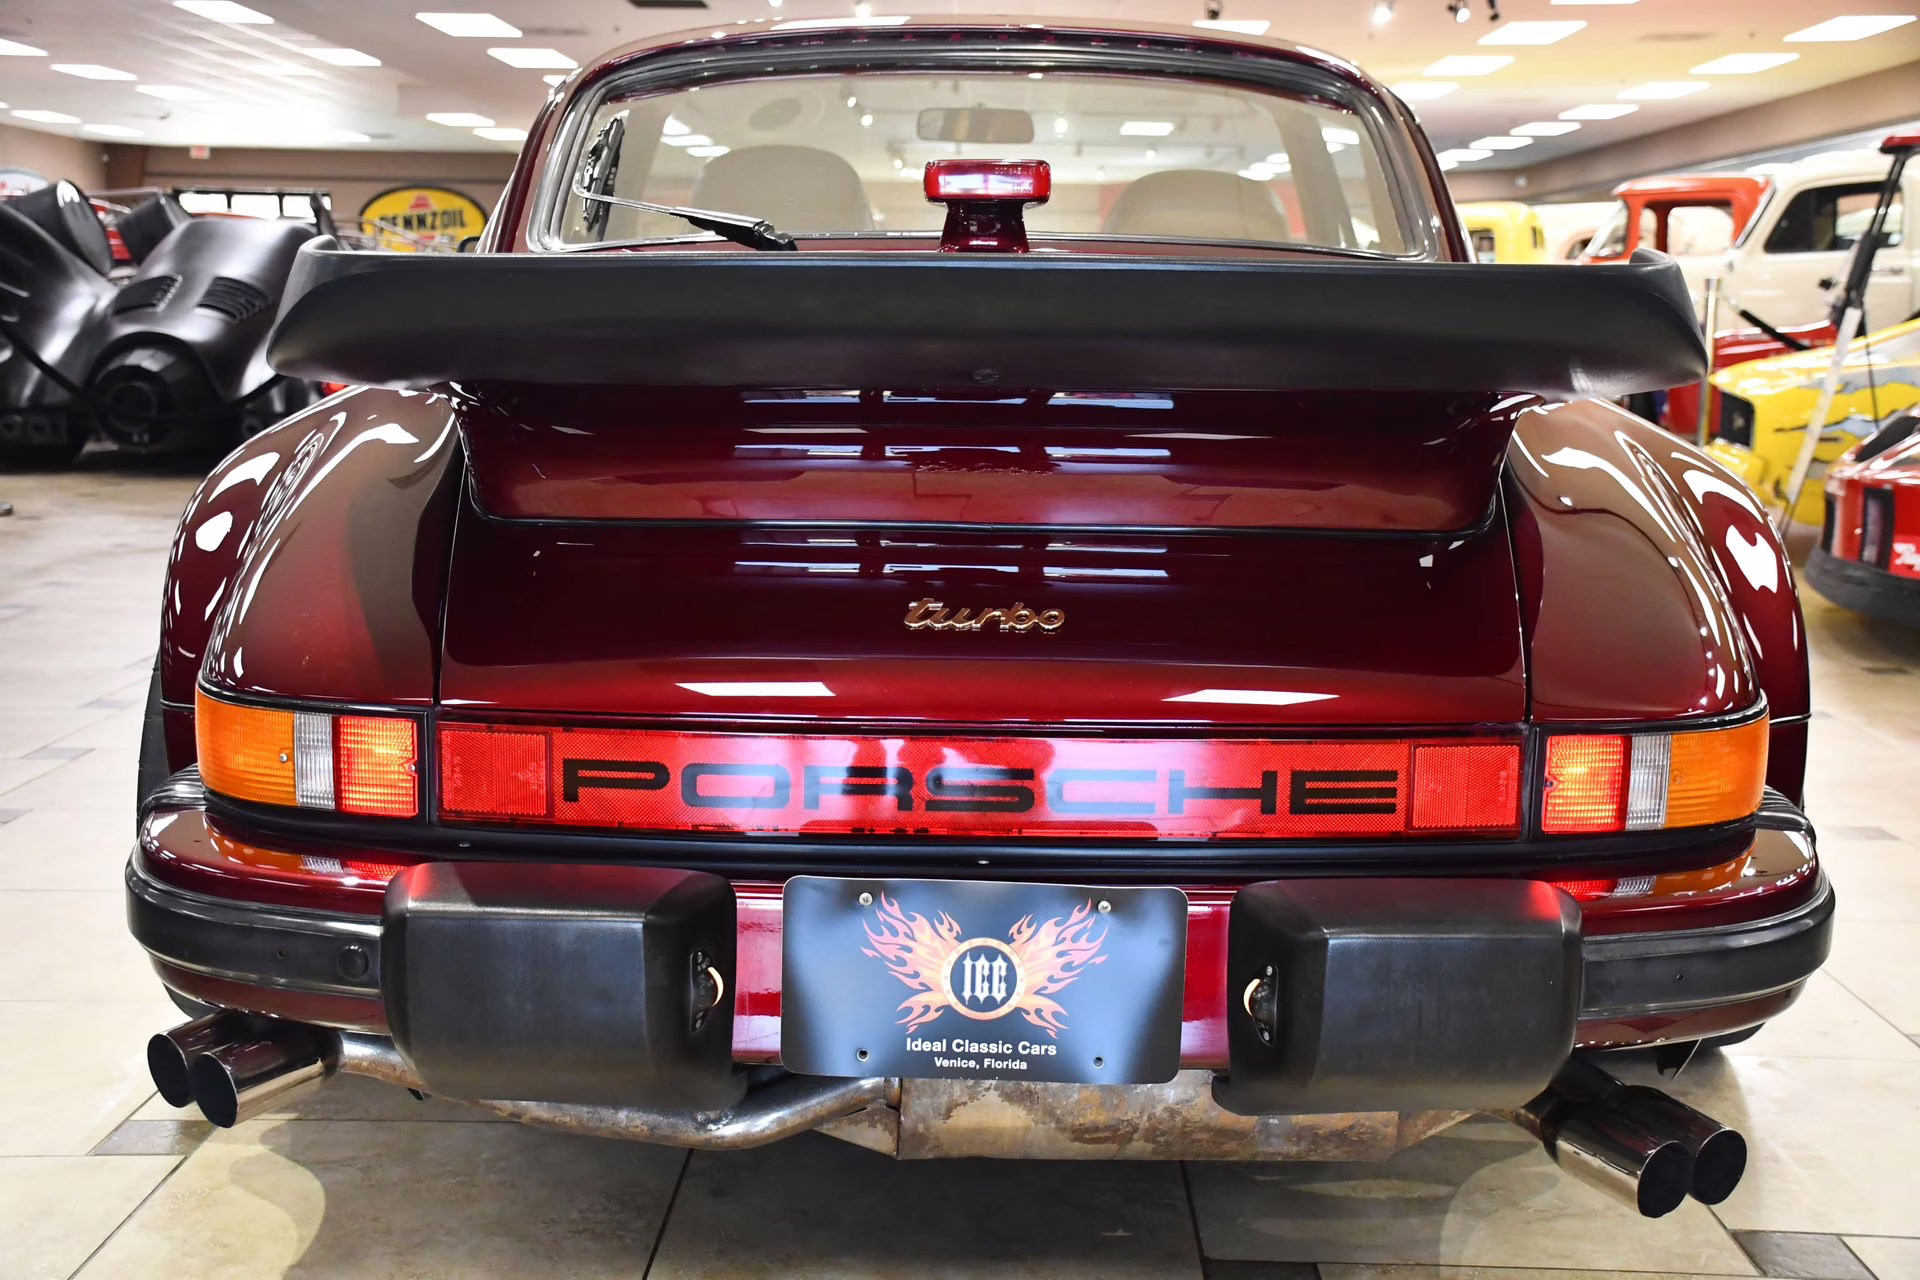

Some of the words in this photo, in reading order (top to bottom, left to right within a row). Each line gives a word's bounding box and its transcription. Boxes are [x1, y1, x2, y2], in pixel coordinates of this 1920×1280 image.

[904, 598, 1066, 634] turbo
[563, 758, 1399, 816] PORSCHE
[906, 1037, 947, 1052] Ideal
[951, 1038, 1013, 1054] Classic
[1017, 1041, 1058, 1056] Cars
[934, 1056, 980, 1070] Venice,
[983, 1058, 1028, 1070] Florida
